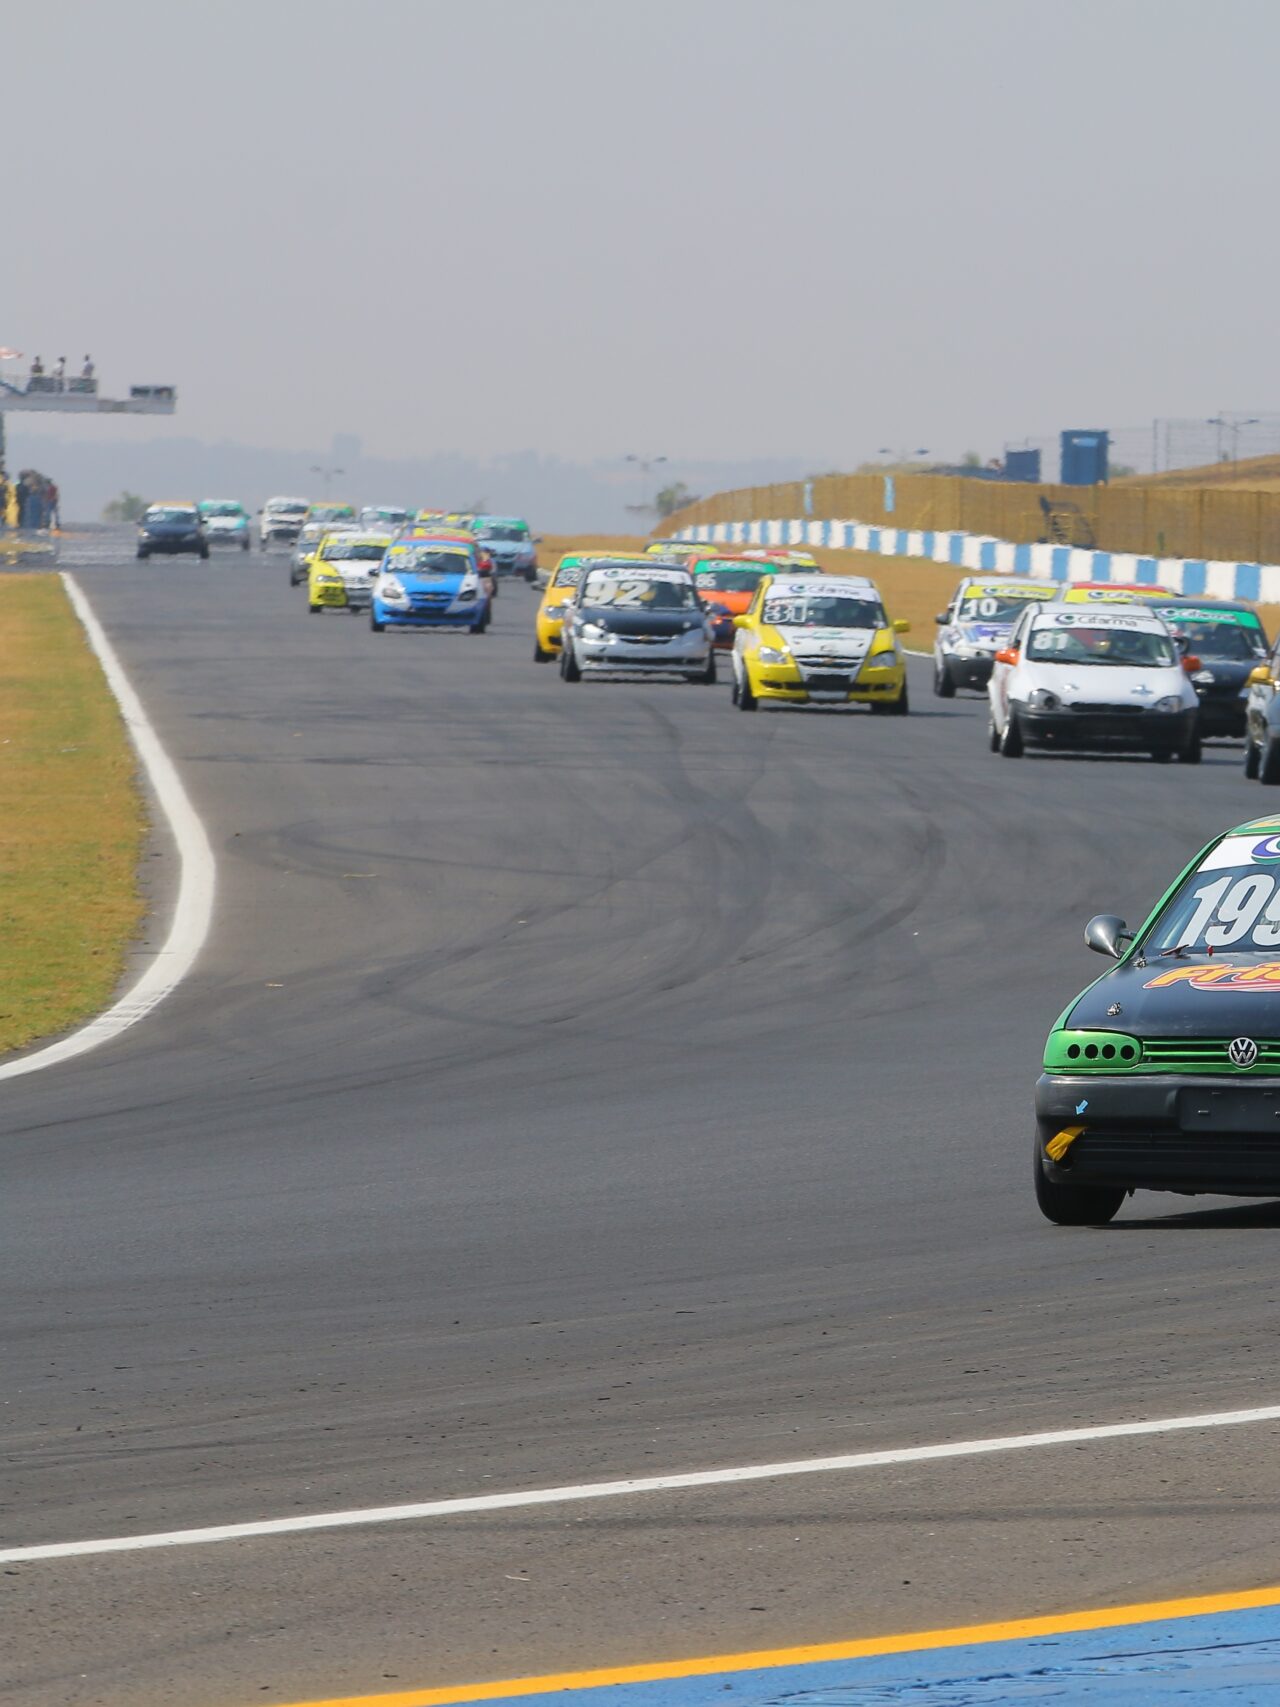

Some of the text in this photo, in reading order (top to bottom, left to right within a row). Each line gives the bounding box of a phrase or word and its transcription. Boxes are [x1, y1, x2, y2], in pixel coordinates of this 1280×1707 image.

[582, 581, 650, 607] 92
[964, 598, 998, 616] 10
[1078, 615, 1137, 627] Cifarma
[1033, 632, 1070, 650] 81
